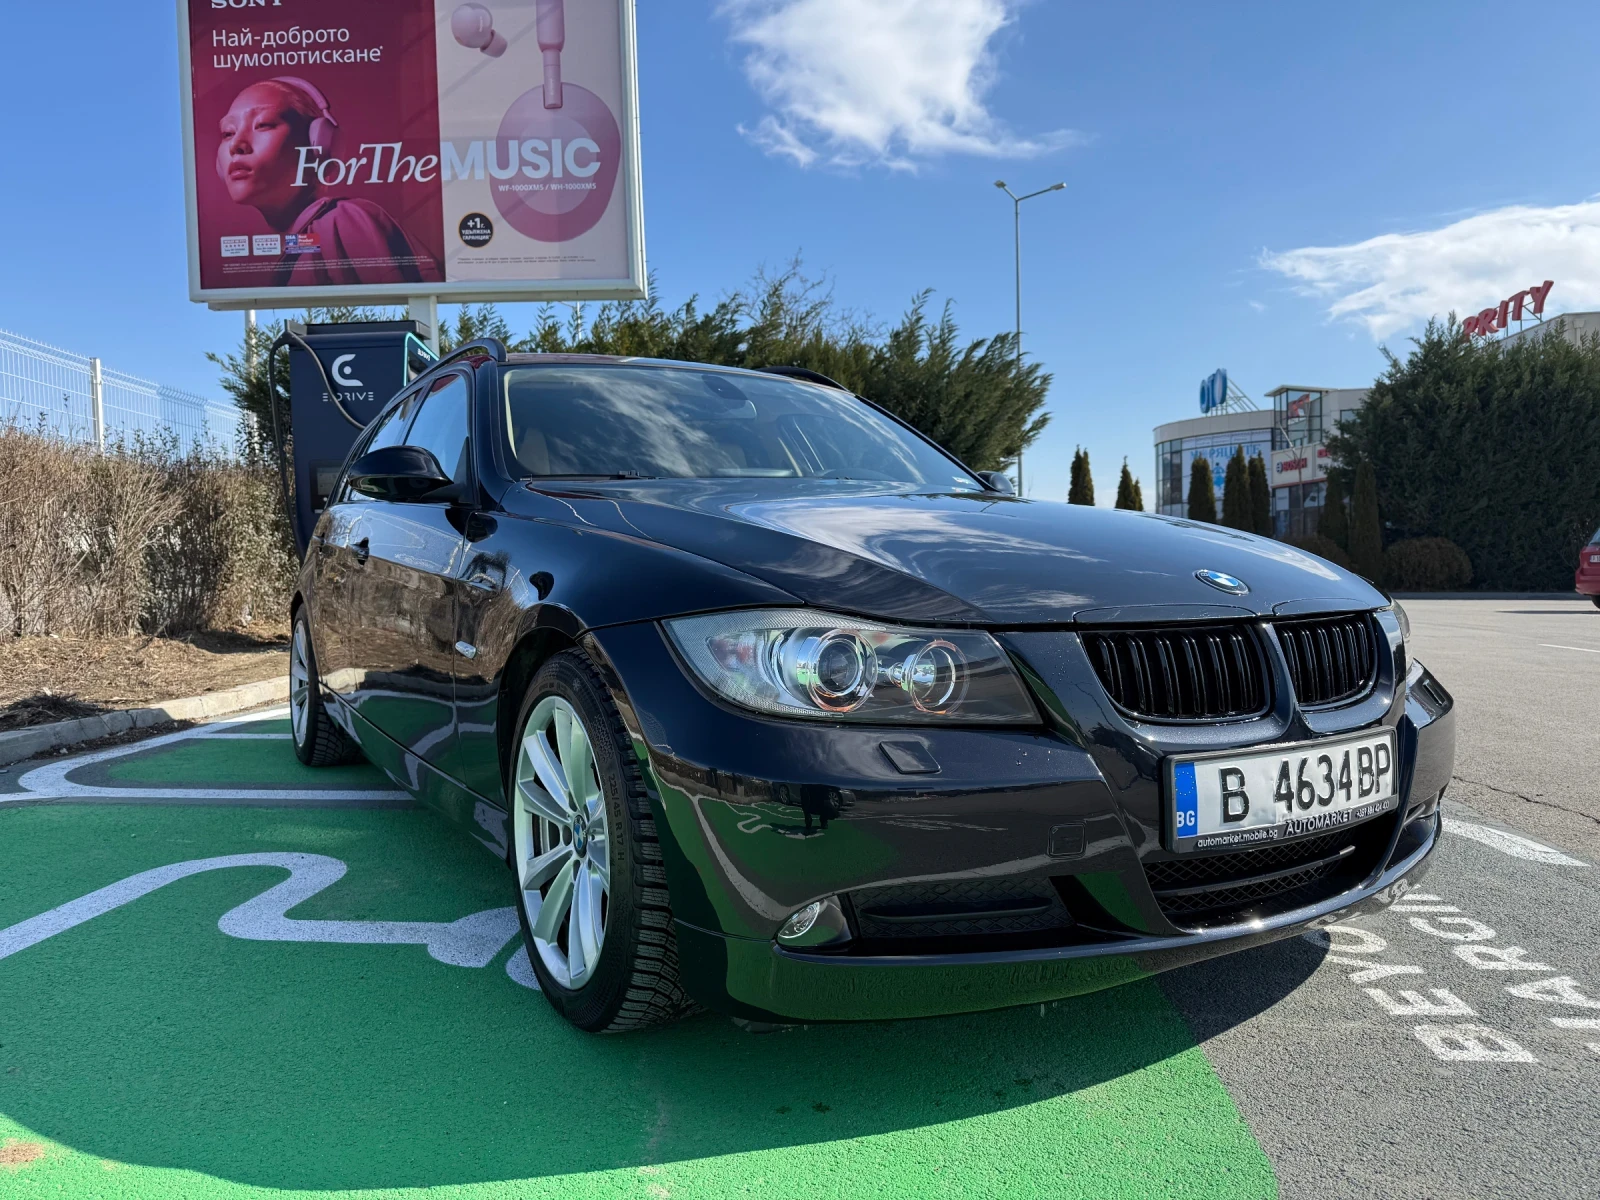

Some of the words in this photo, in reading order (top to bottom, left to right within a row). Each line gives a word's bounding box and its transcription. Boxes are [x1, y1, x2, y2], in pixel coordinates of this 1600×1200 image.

[212, 26, 350, 49] Най-доброто
[441, 138, 601, 181] MUSIC
[498, 184, 544, 192] WF-1000XM5
[550, 182, 597, 190] WH-1000XM5
[1462, 280, 1554, 342] PRITY
[322, 391, 374, 402] EDRIVE
[1218, 766, 1250, 824] B
[1177, 810, 1196, 828] BG
[1197, 828, 1278, 848] automarket.mobile.bg
[1285, 809, 1353, 836] AUTOMARKET
